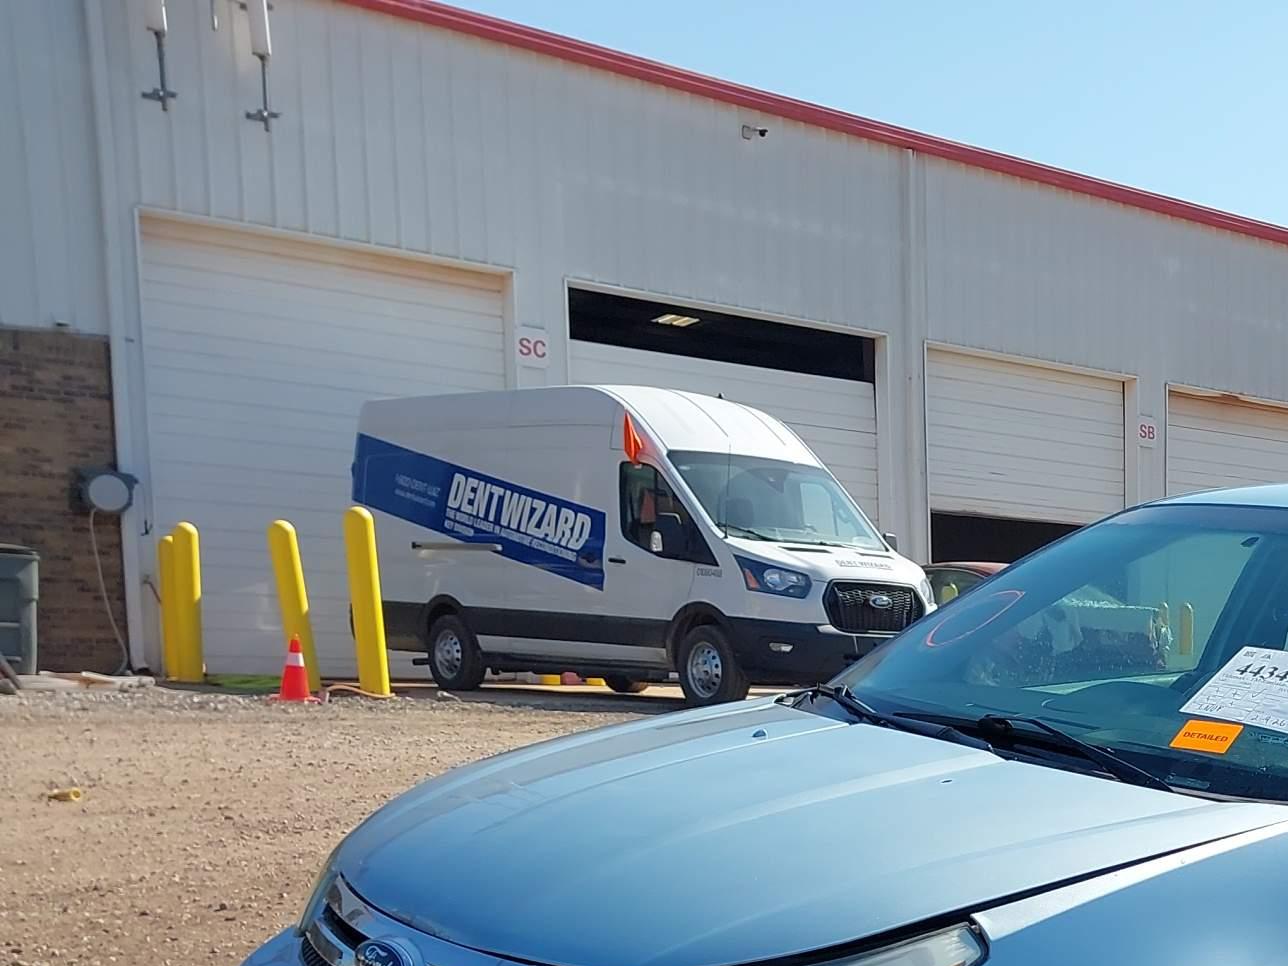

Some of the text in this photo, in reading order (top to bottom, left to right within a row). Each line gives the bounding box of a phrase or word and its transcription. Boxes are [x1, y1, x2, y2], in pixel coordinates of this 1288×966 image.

[519, 337, 546, 358] SC
[1139, 424, 1155, 440] SB
[1182, 730, 1229, 743] DETAILED
